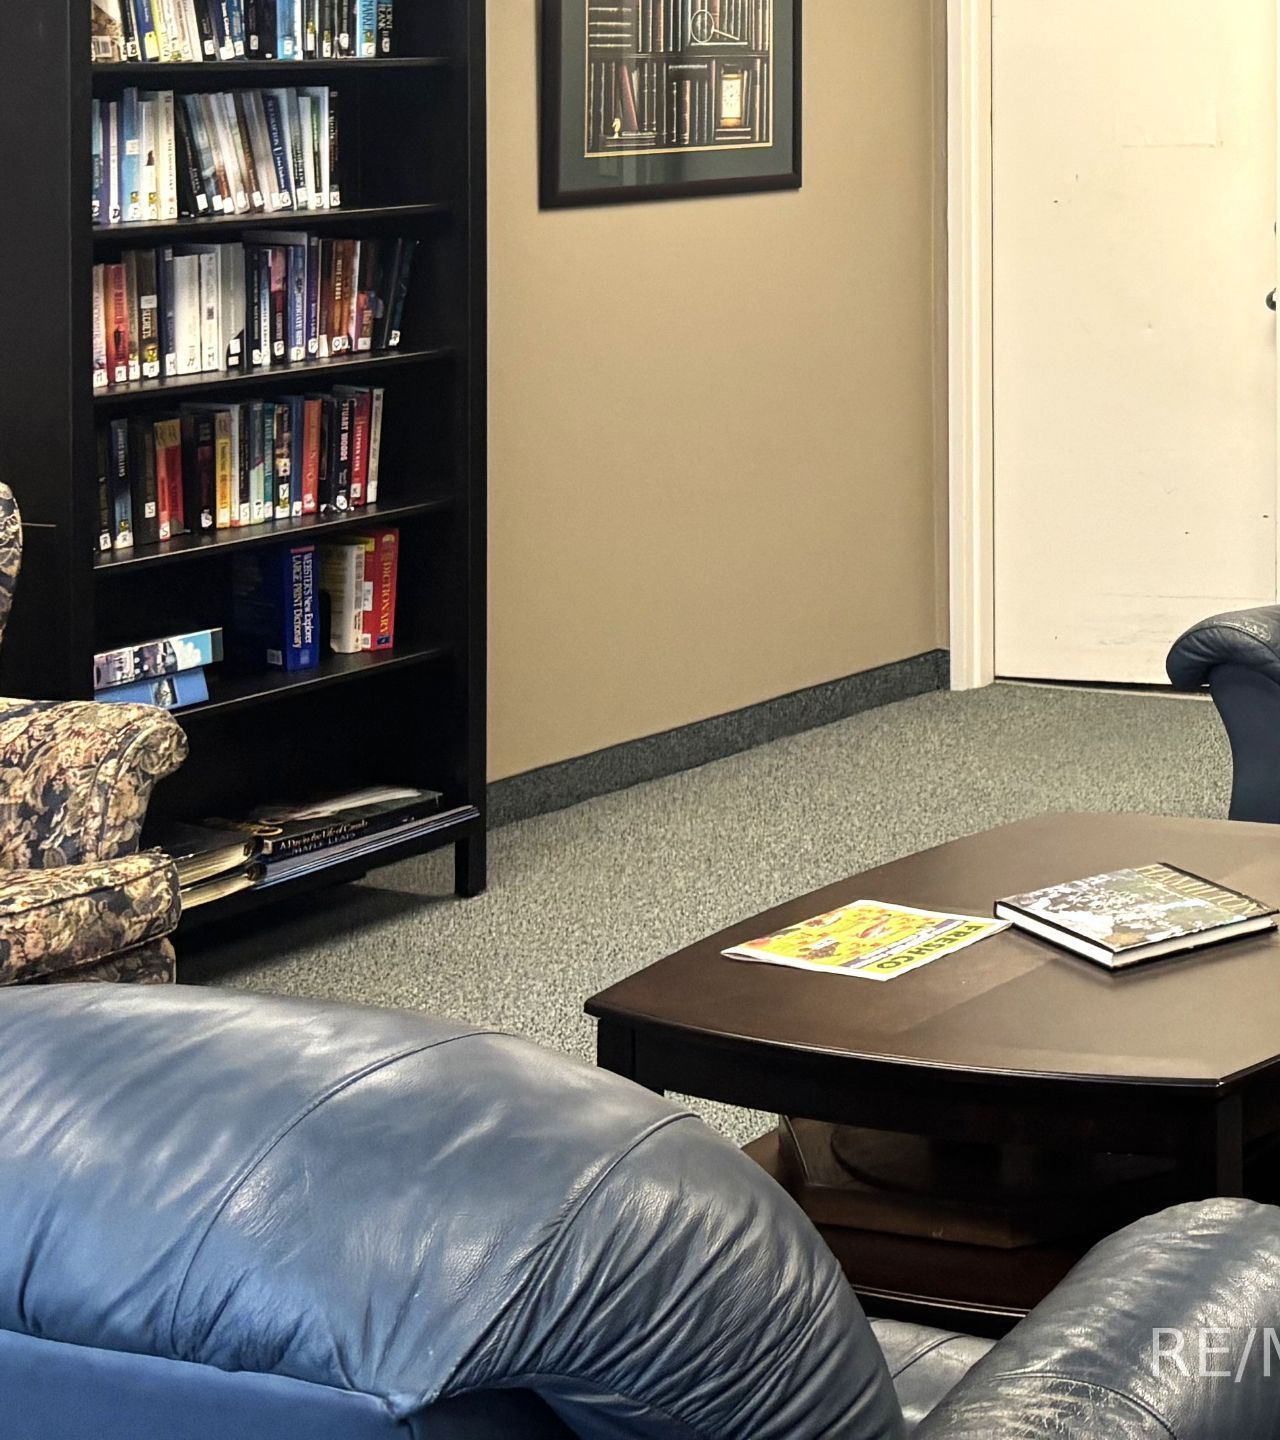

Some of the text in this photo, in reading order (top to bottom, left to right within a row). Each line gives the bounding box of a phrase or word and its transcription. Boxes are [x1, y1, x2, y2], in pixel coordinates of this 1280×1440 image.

[377, 4, 394, 30] POINT BLANK
[142, 308, 152, 339] SECRETS
[340, 402, 349, 462] STUART WOODS
[355, 425, 363, 454] STEPHEN
[292, 553, 304, 648] LARGE PRINT Dictionary
[302, 552, 314, 644] WEBSTER'S New Explorer
[379, 560, 392, 634] DICTIONARY
[1135, 862, 1270, 917] HAMILTON
[876, 923, 985, 970] FRESHCO
